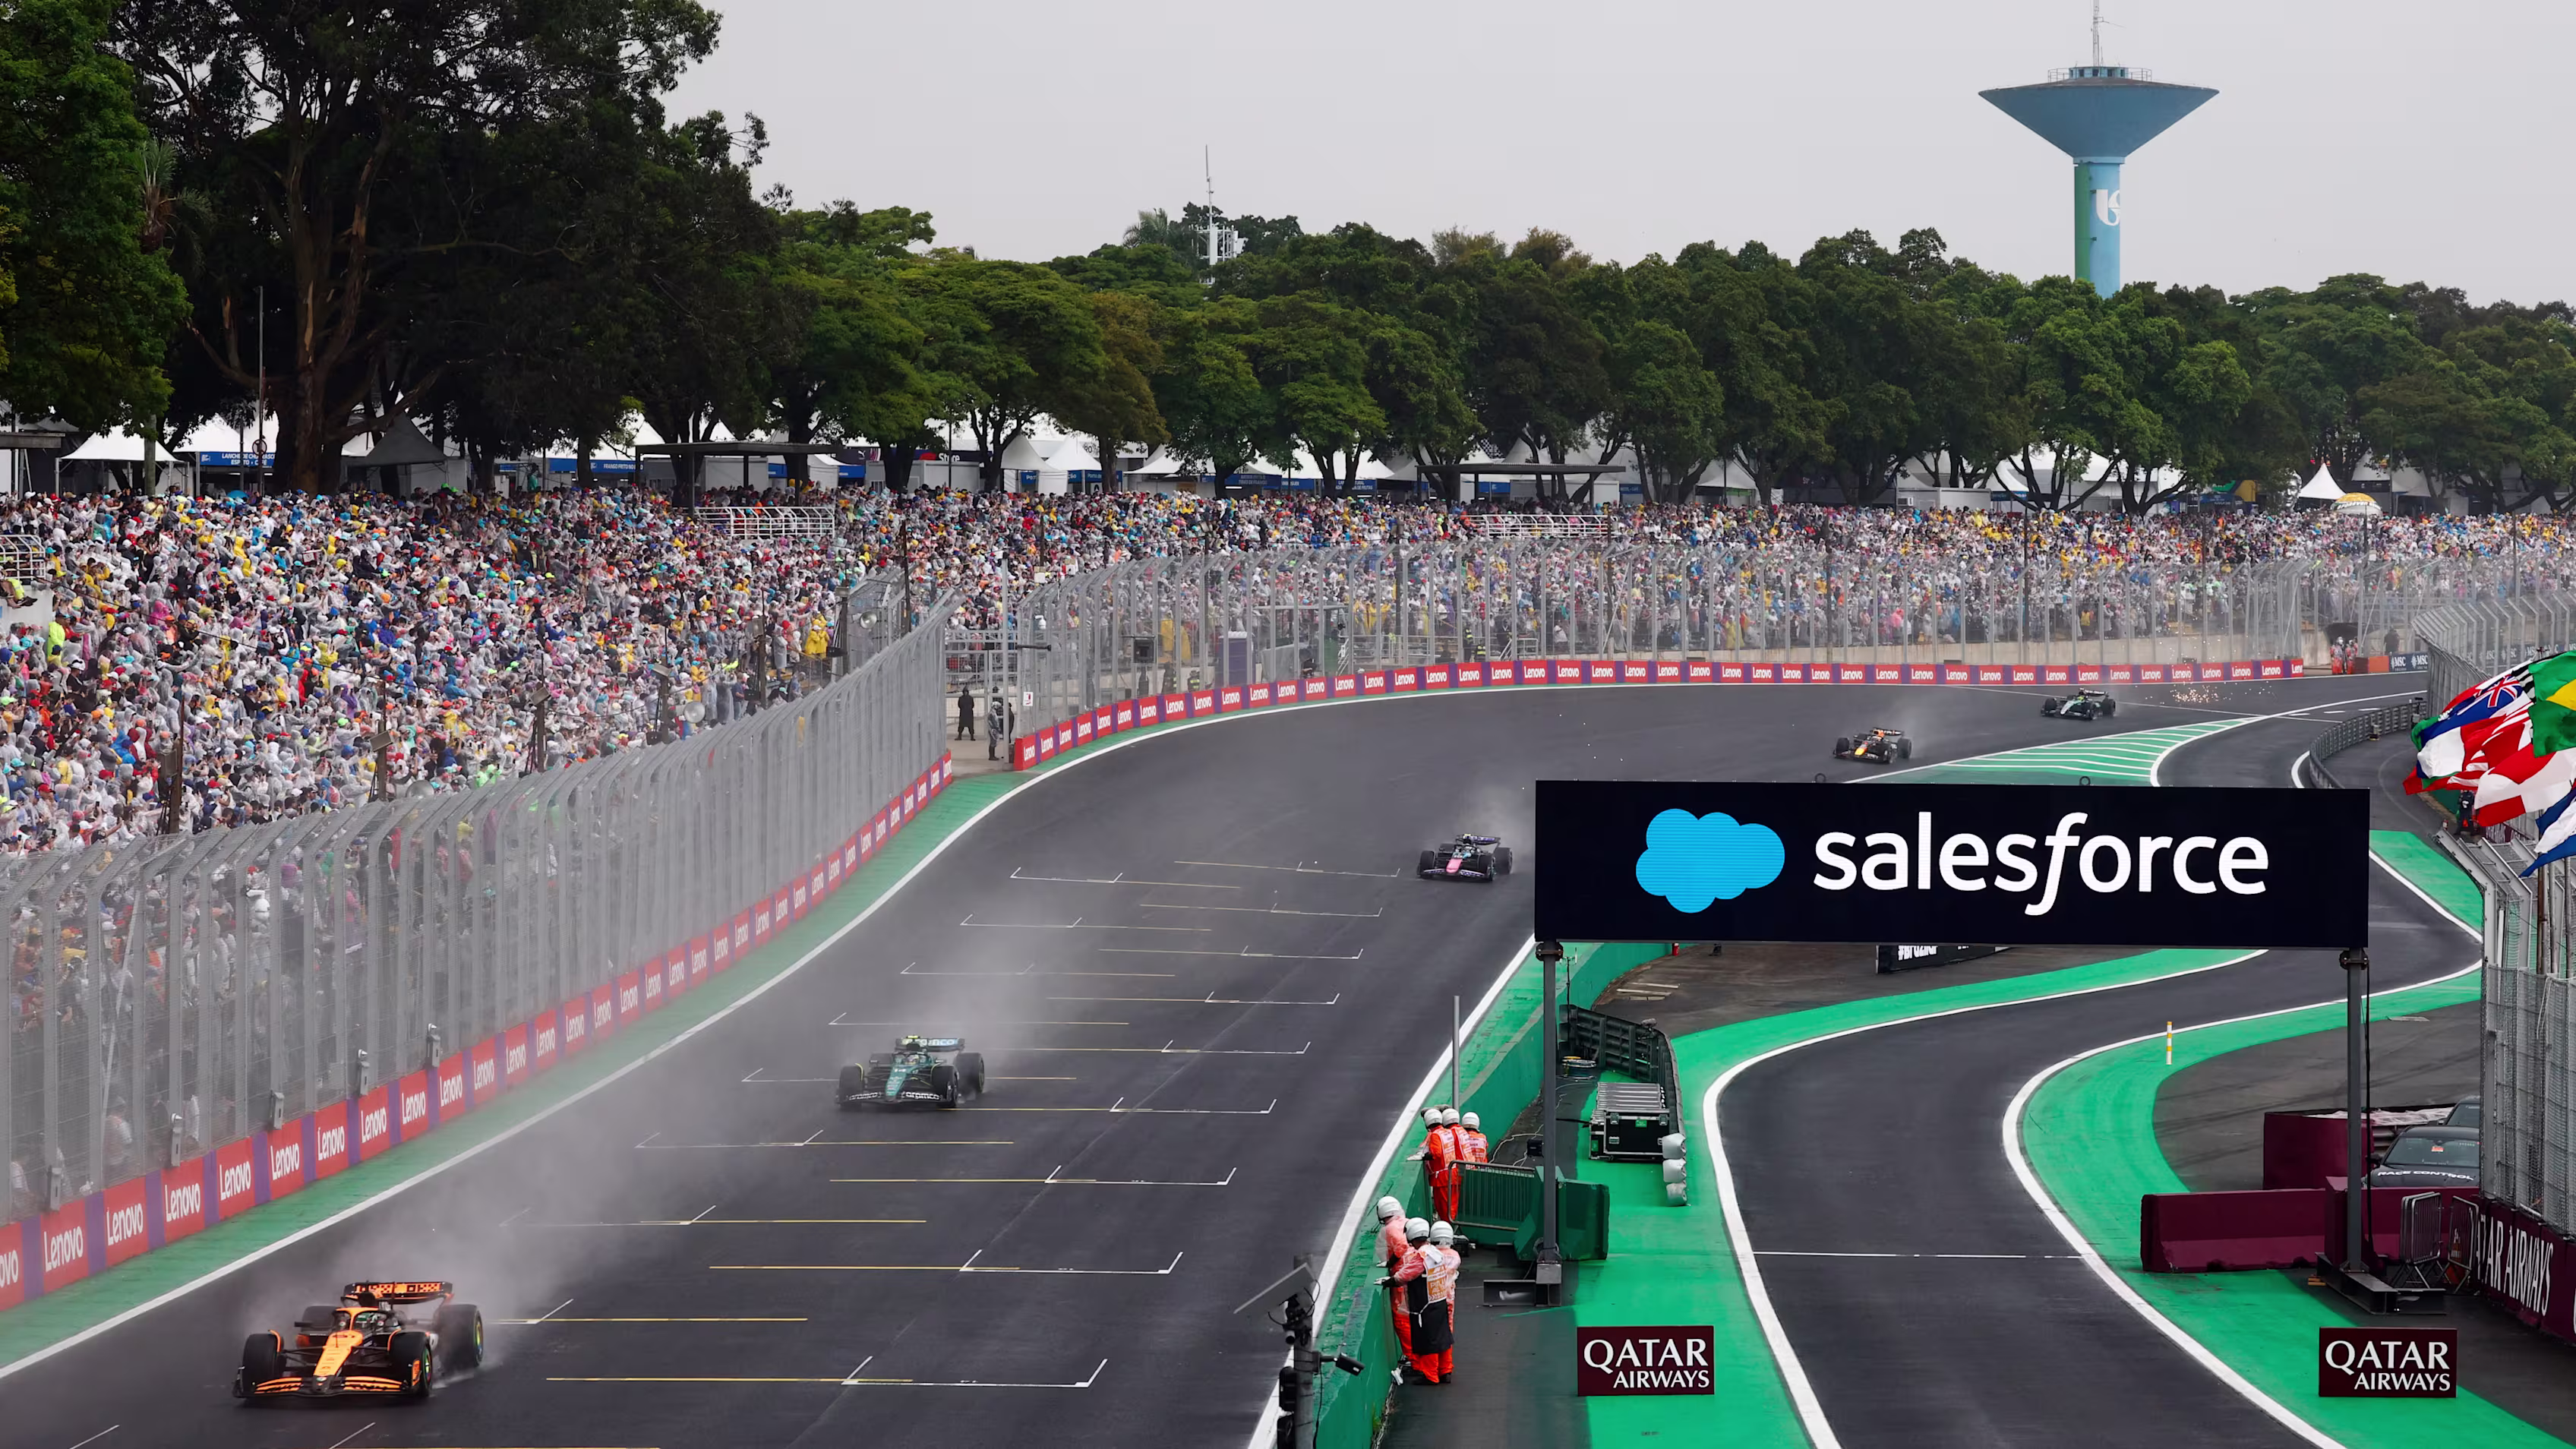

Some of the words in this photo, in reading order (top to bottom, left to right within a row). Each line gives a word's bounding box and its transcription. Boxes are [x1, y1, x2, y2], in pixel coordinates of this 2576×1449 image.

[2394, 657, 2406, 667] MSC
[2417, 655, 2428, 665] MSC
[1426, 671, 1447, 683] Lenovo
[1460, 670, 1479, 682] Lenovo
[1492, 668, 1511, 680] Lenovo
[1524, 667, 1545, 678] Lenovo
[1558, 665, 1579, 678] Lenovo
[1592, 665, 1613, 678] Lenovo
[1625, 665, 1646, 677] Lenovo
[1659, 665, 1678, 677] Lenovo
[1690, 665, 1710, 677] Lenovo
[1722, 667, 1741, 678] Lenovo
[1753, 667, 1771, 679] Lenovo
[1782, 668, 1801, 680] Lenovo
[1812, 669, 1829, 680] Lenovo
[1842, 669, 1862, 680] Lenovo
[1877, 669, 1898, 680] Lenovo
[1912, 668, 1934, 680] Lenovo
[1946, 670, 1967, 681] Lenovo
[1981, 671, 2000, 681] Lenovo
[2014, 671, 2034, 681] Lenovo
[2047, 671, 2066, 681] Lenovo
[2079, 671, 2098, 681] Lenovo
[2110, 670, 2129, 681] Lenovo
[2142, 670, 2161, 681] Lenovo
[2172, 669, 2192, 680] Lenovo
[2202, 668, 2221, 679] Lenovo
[2232, 668, 2251, 677] Lenovo
[2262, 666, 2281, 676] Lenovo
[1335, 678, 1353, 690] Lenovo
[1365, 676, 1384, 688] Lenovo
[1395, 673, 1414, 685] Lenovo
[1250, 688, 1268, 700] Lenovo
[1277, 685, 1296, 697] Lenovo
[1306, 681, 1324, 693] Lenovo
[1195, 696, 1211, 709] Lenovo
[1223, 691, 1239, 705] Lenovo
[1141, 706, 1156, 718] Lenovo
[1166, 700, 1183, 714] Lenovo
[1097, 715, 1110, 729] Lenovo
[1118, 709, 1132, 724] Lenovo
[1059, 729, 1071, 745] Lenovo
[1078, 722, 1091, 737] Lenovo
[1041, 737, 1053, 753] Lenovo
[1024, 746, 1034, 761] Lenovo
[931, 770, 939, 789] Lenovo
[917, 782, 927, 802] Lenovo
[904, 794, 913, 814] Lenovo
[891, 807, 899, 827] Lenovo
[876, 819, 886, 841] Lenovo
[861, 832, 871, 854] Lenovo
[846, 845, 855, 868] Lenovo
[1814, 812, 2268, 915] salesforce
[829, 860, 840, 881] Lenovo
[813, 872, 823, 895] Lenovo
[794, 886, 805, 909] Lenovo
[776, 898, 787, 922] Lenovo
[756, 911, 769, 936] Lenovo
[735, 923, 748, 948] Lenovo
[715, 937, 728, 961] Lenovo
[692, 949, 706, 974] Lenovo
[670, 961, 683, 986] Lenovo
[646, 974, 661, 999] Lenovo
[620, 986, 638, 1013] Lenovo
[595, 1000, 611, 1028] Lenovo
[567, 1015, 584, 1042] Lenovo
[537, 1028, 554, 1057] Lenovo
[507, 1043, 526, 1074] Lenovo
[474, 1059, 494, 1090] Lenovo
[440, 1074, 462, 1106] Lenovo
[402, 1091, 425, 1124] Lenovo
[361, 1107, 387, 1143] Lenovo
[317, 1126, 345, 1160] Lenovo
[270, 1144, 299, 1180] Lenovo
[220, 1161, 251, 1200] Lenovo
[2413, 1170, 2474, 1180] CONTROL
[166, 1183, 200, 1222] Lenovo
[107, 1204, 143, 1245] Lenovo
[44, 1226, 83, 1271] Lenovo
[0, 1250, 18, 1287] ovo
[2503, 1226, 2553, 1316] AIRWAYS
[1584, 1339, 1708, 1374] QATAR
[2325, 1341, 2449, 1375] QATAR
[1614, 1370, 1709, 1387] AIRWAYS
[2354, 1373, 2450, 1391] AIRWAYS
